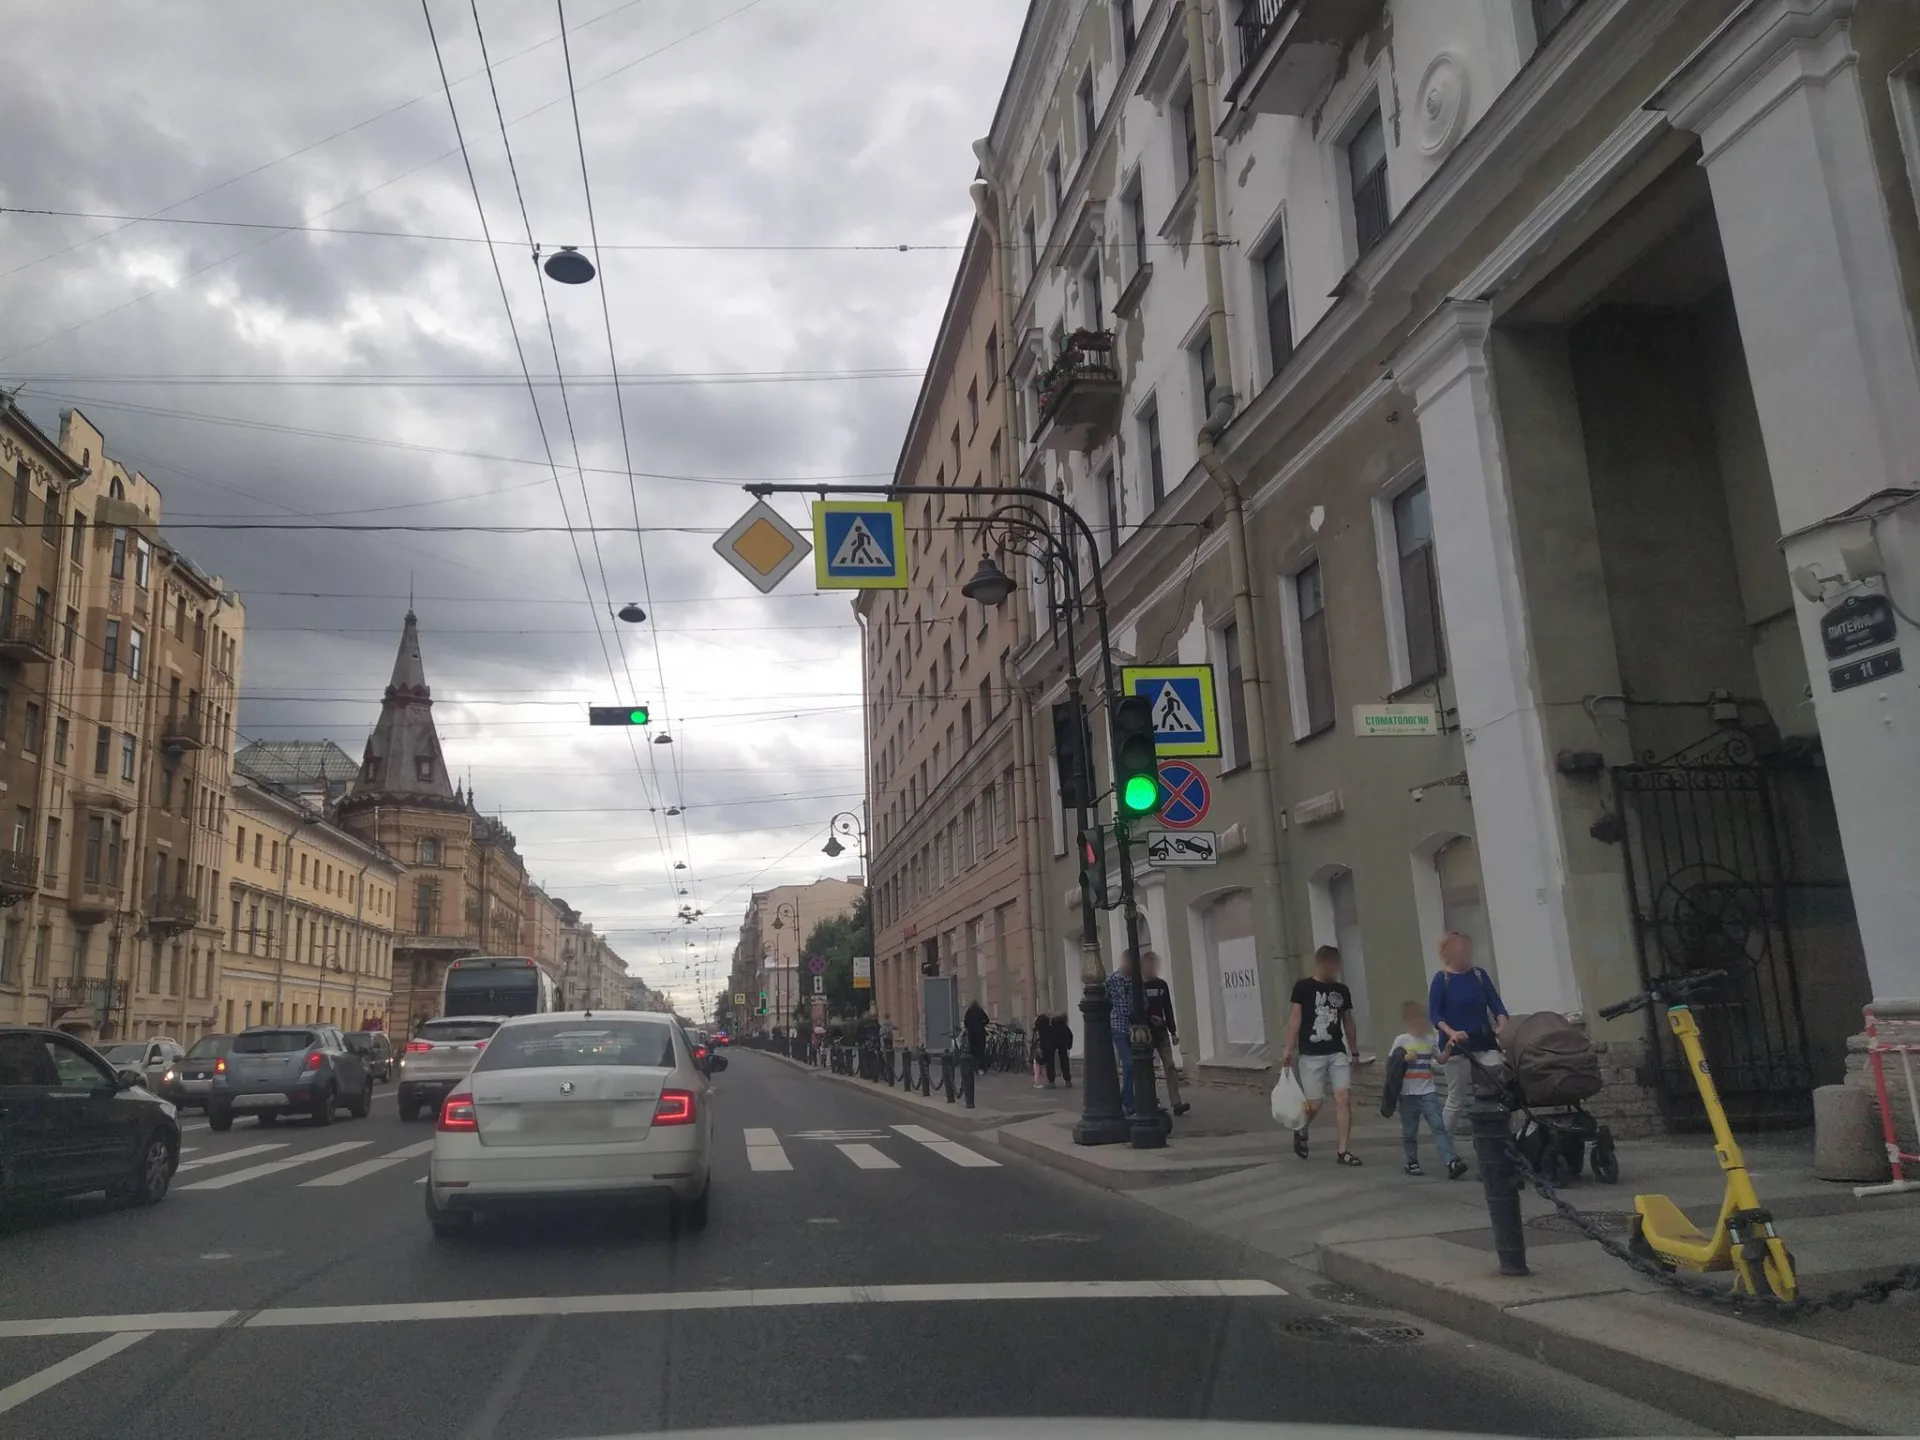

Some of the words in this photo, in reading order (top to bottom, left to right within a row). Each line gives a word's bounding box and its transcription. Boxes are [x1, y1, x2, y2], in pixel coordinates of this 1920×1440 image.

[1860, 660, 1873, 677] 11
[1365, 715, 1429, 726] СТОМАТОЛОГИЯ
[1224, 968, 1256, 988] ROSSI
